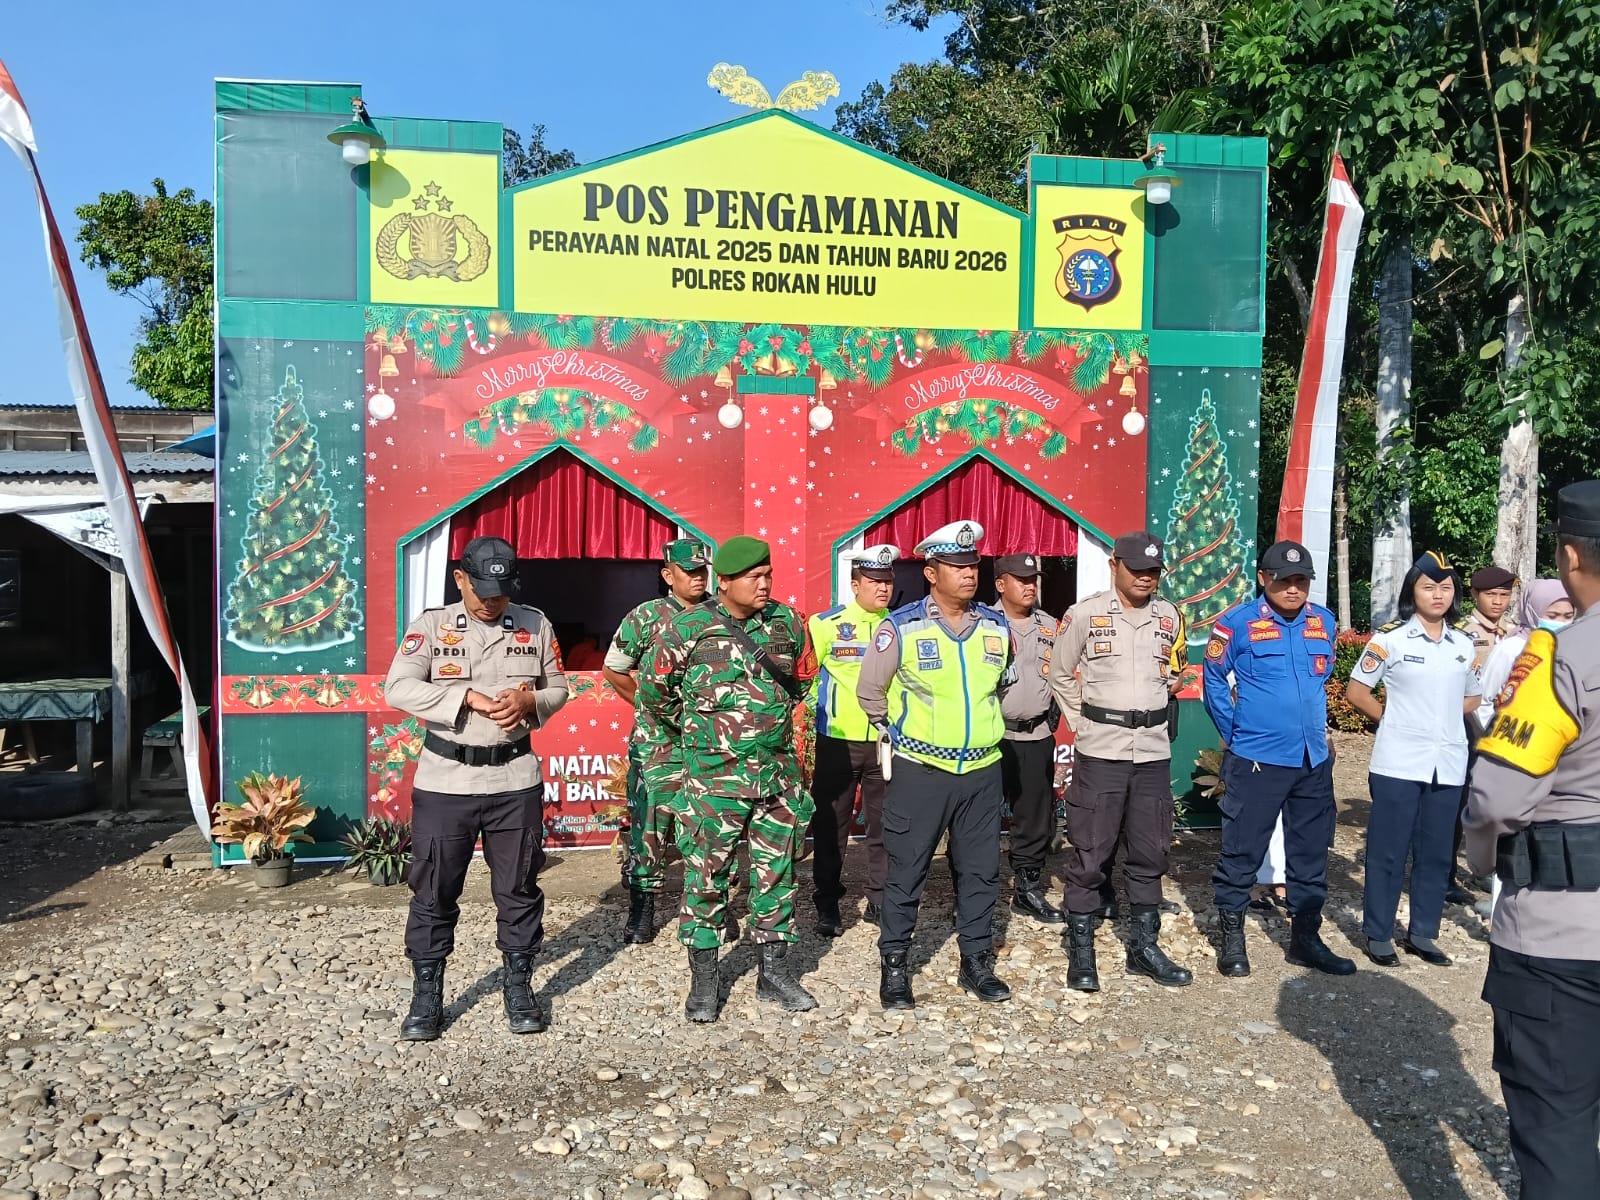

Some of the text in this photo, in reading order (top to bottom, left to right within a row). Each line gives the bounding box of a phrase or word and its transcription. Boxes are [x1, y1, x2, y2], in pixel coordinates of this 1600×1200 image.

[584, 182, 960, 240] POS PENGAMANAN
[1061, 218, 1118, 231] RIAU
[529, 229, 1008, 273] PERAYAAN NATAL 2025 DAN TAHUN BARU 2026
[671, 267, 876, 297] POLRES ROKAN HULU
[476, 351, 649, 401] Merry Christmas
[904, 363, 1060, 410] Merry Christmas
[433, 646, 537, 657] DEDI POLRI
[1088, 629, 1117, 638] AGUS
[1492, 713, 1535, 750] PAM
